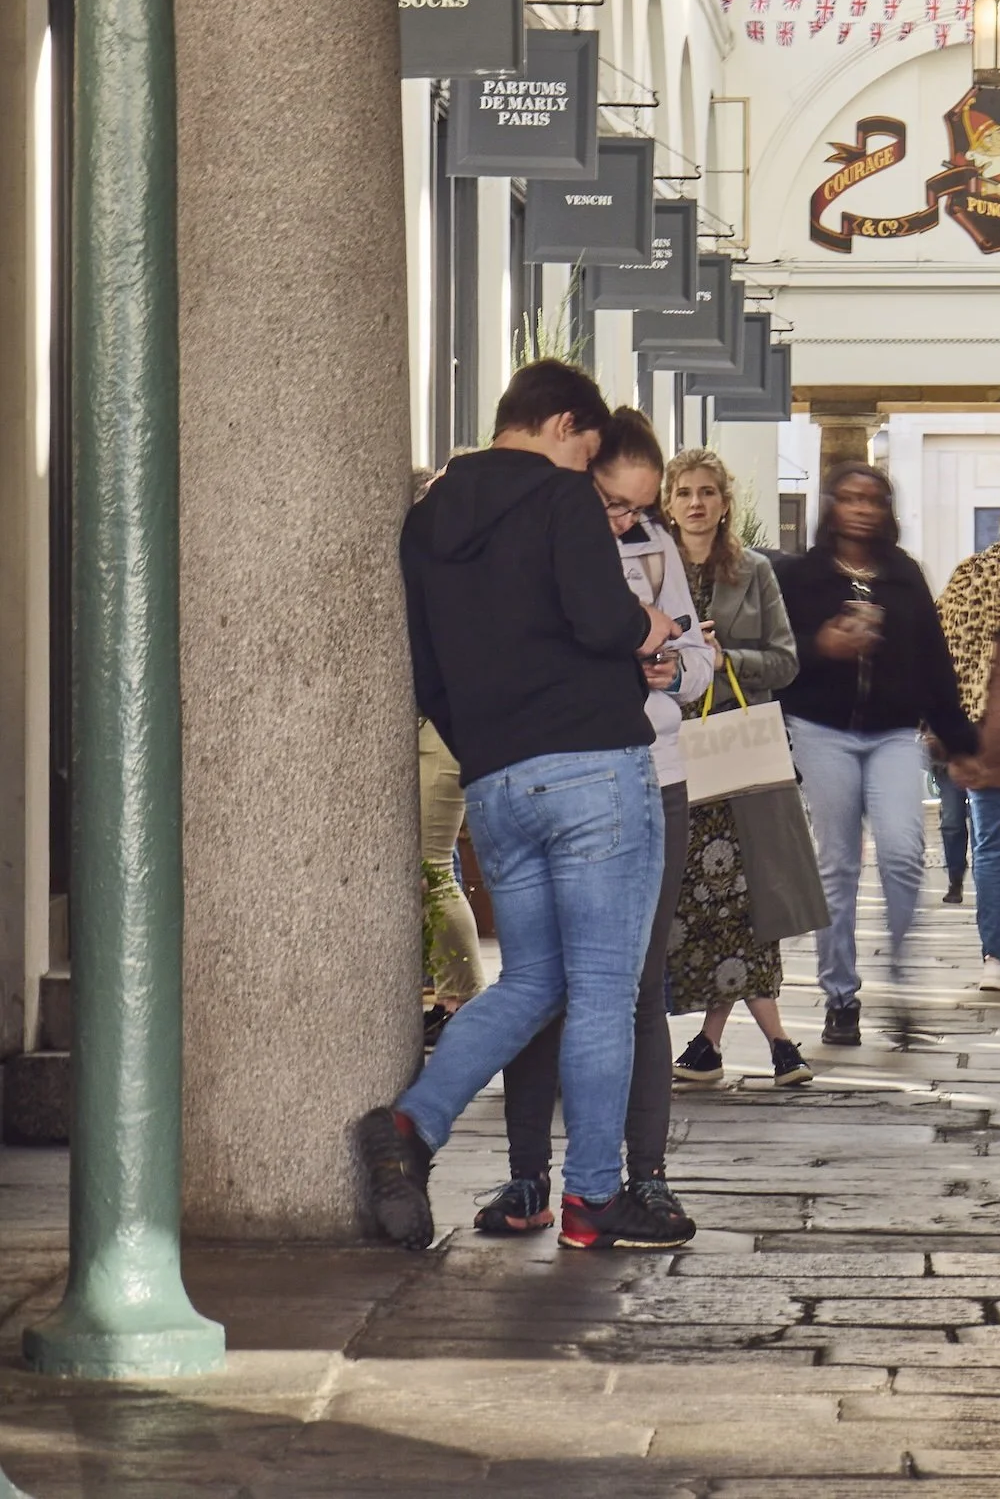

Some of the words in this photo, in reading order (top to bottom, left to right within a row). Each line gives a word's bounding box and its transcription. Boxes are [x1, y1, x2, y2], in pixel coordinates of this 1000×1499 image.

[482, 80, 567, 96] PARFUMS
[479, 95, 505, 110] DE
[507, 96, 569, 111] MARLY
[497, 111, 551, 126] PARIS
[823, 146, 895, 200] COURAGE
[565, 194, 613, 205] VENCHI
[861, 219, 877, 236] &
